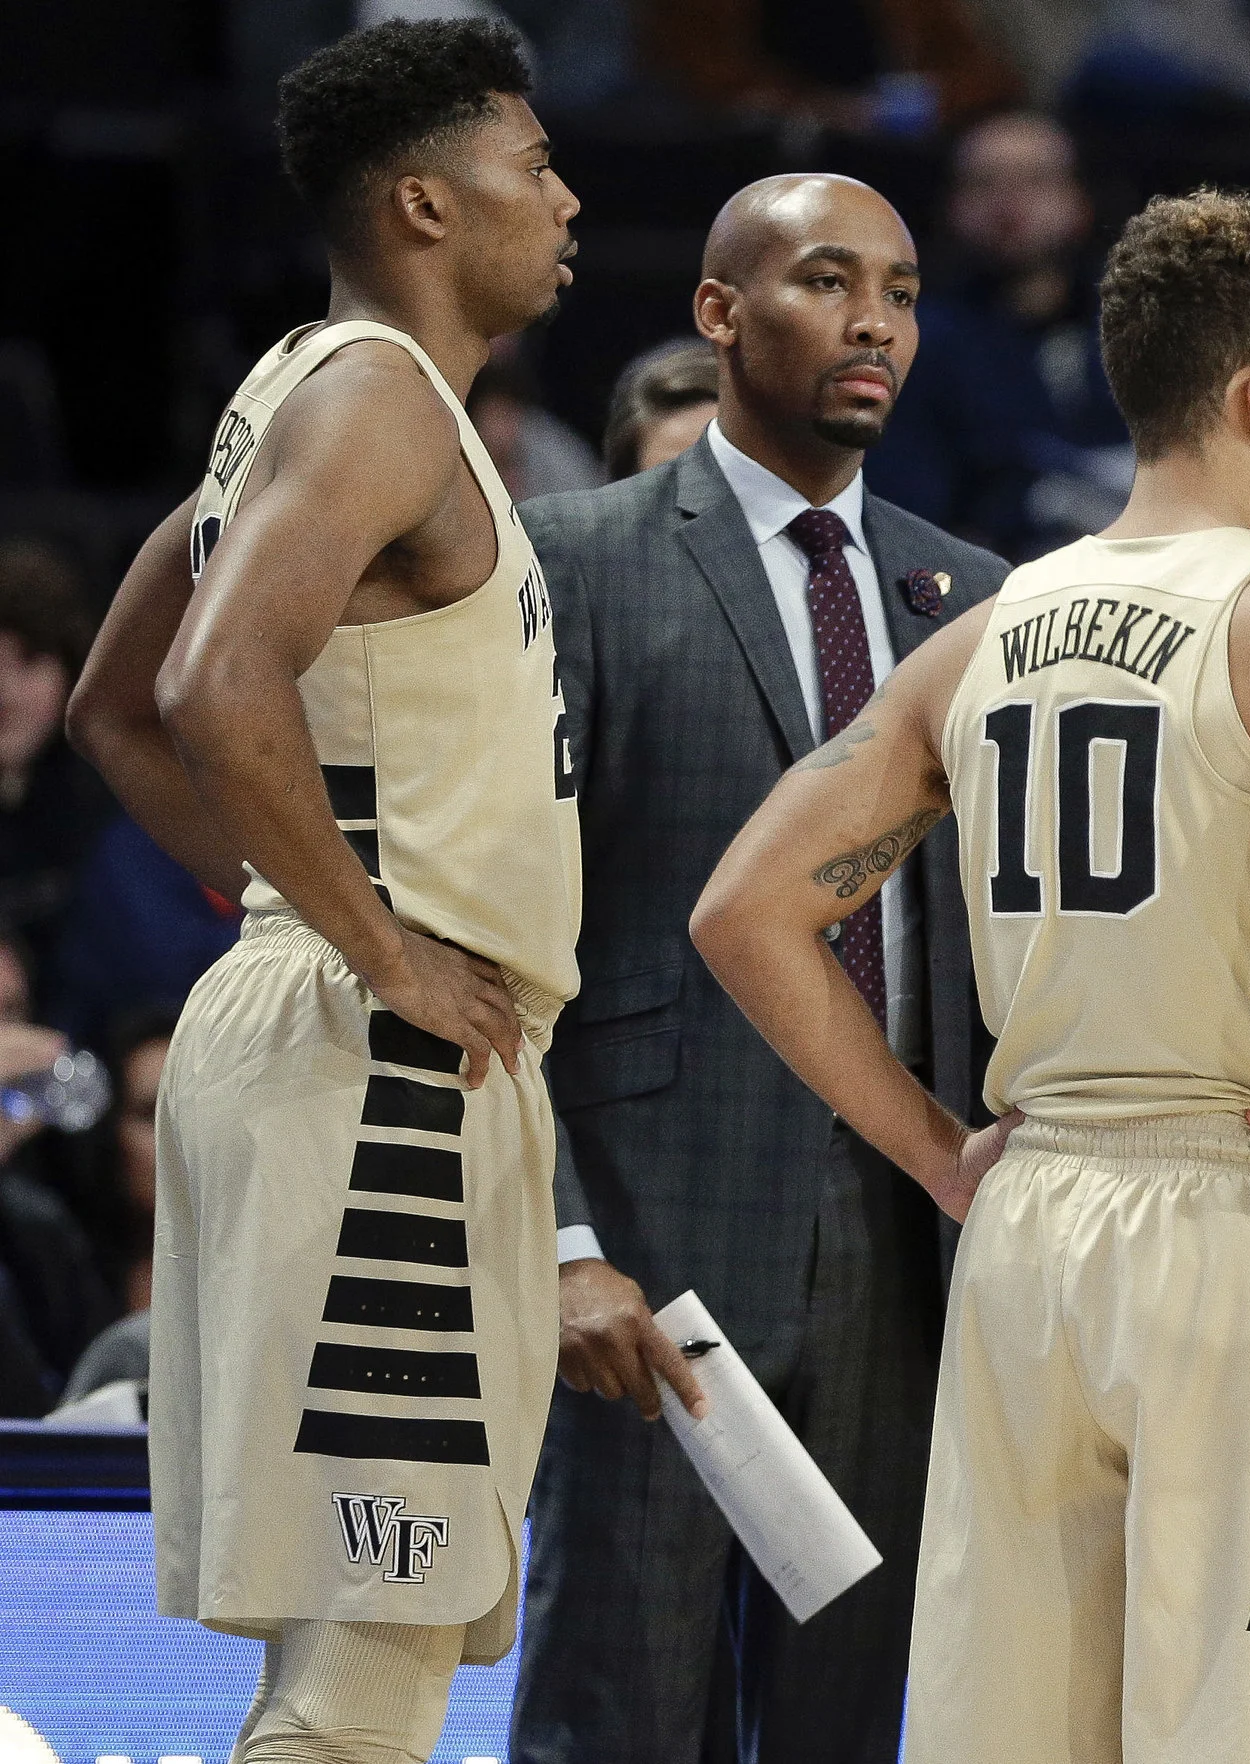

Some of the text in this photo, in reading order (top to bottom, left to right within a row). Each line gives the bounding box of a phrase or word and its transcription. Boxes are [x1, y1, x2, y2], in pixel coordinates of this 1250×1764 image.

[1000, 598, 1196, 685] WILBEKIN
[981, 696, 1166, 920] 10
[331, 1492, 450, 1584] WF
